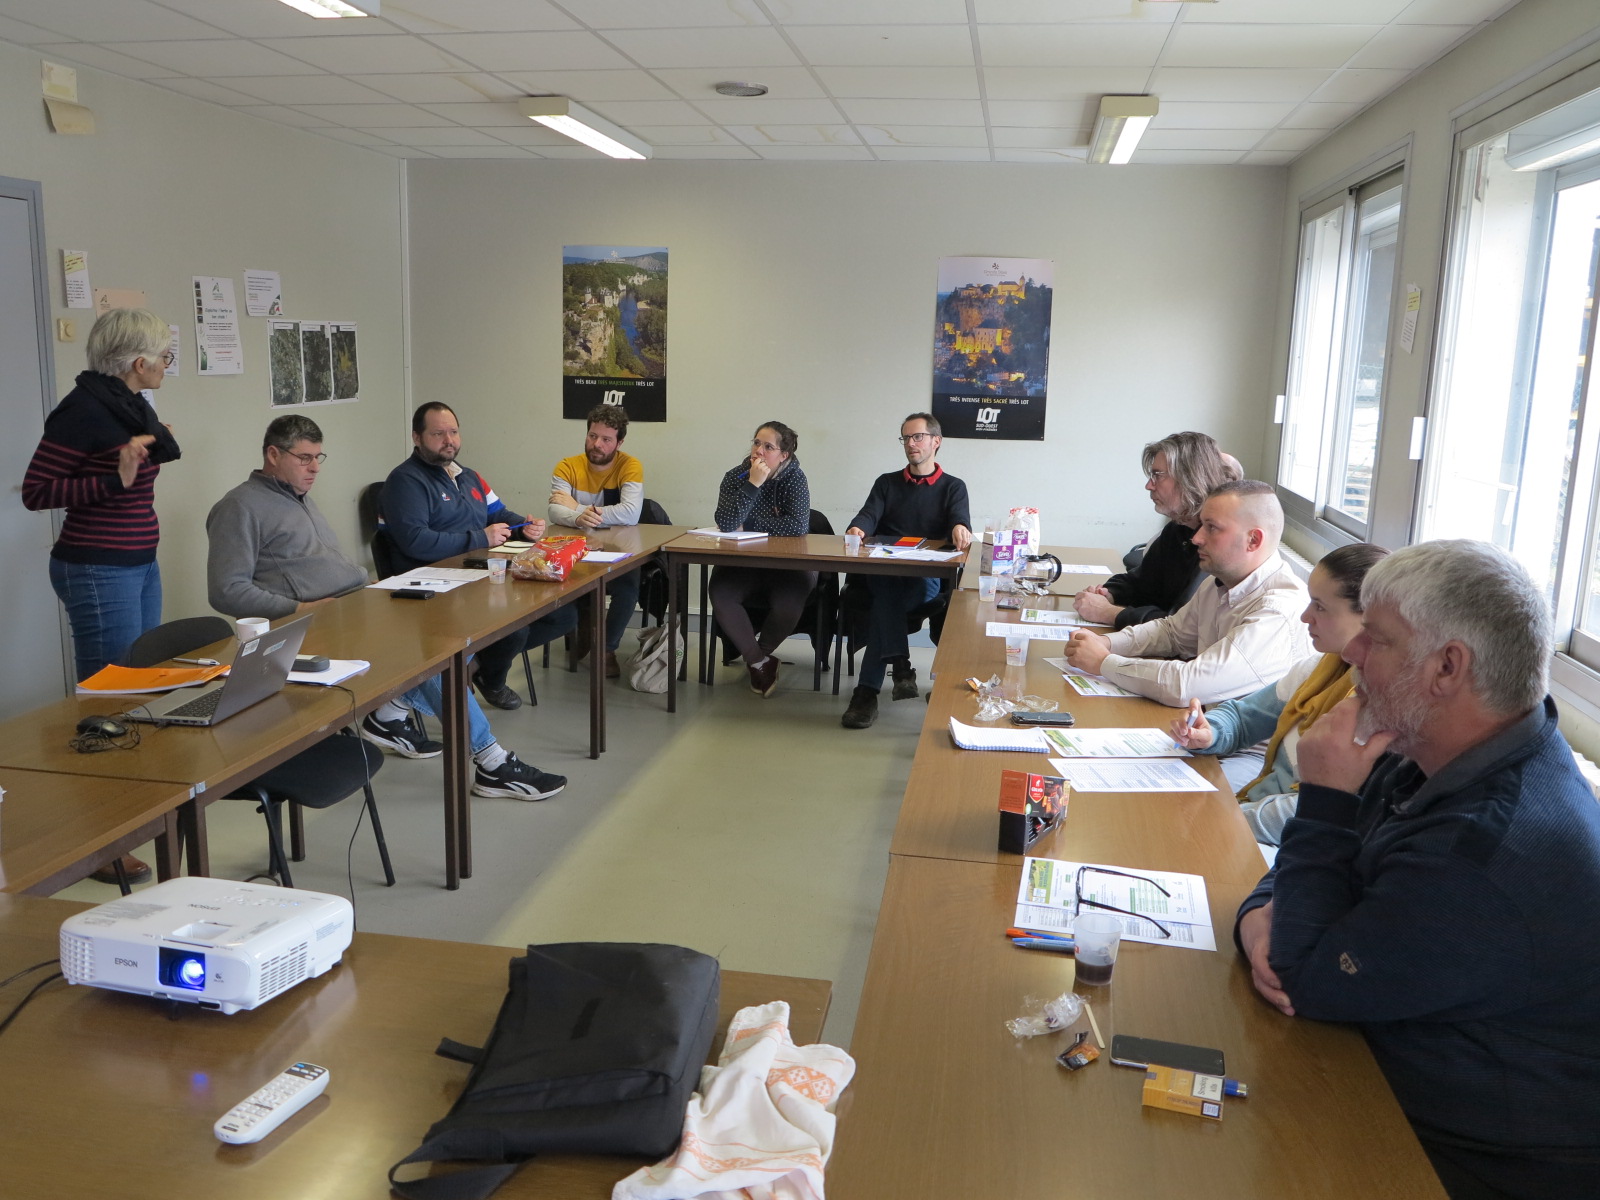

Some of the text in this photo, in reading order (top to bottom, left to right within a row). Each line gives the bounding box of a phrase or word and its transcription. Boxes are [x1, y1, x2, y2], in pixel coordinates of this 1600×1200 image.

[603, 390, 626, 406] LOT
[976, 408, 1001, 424] LOT
[114, 958, 138, 968] EPSON
